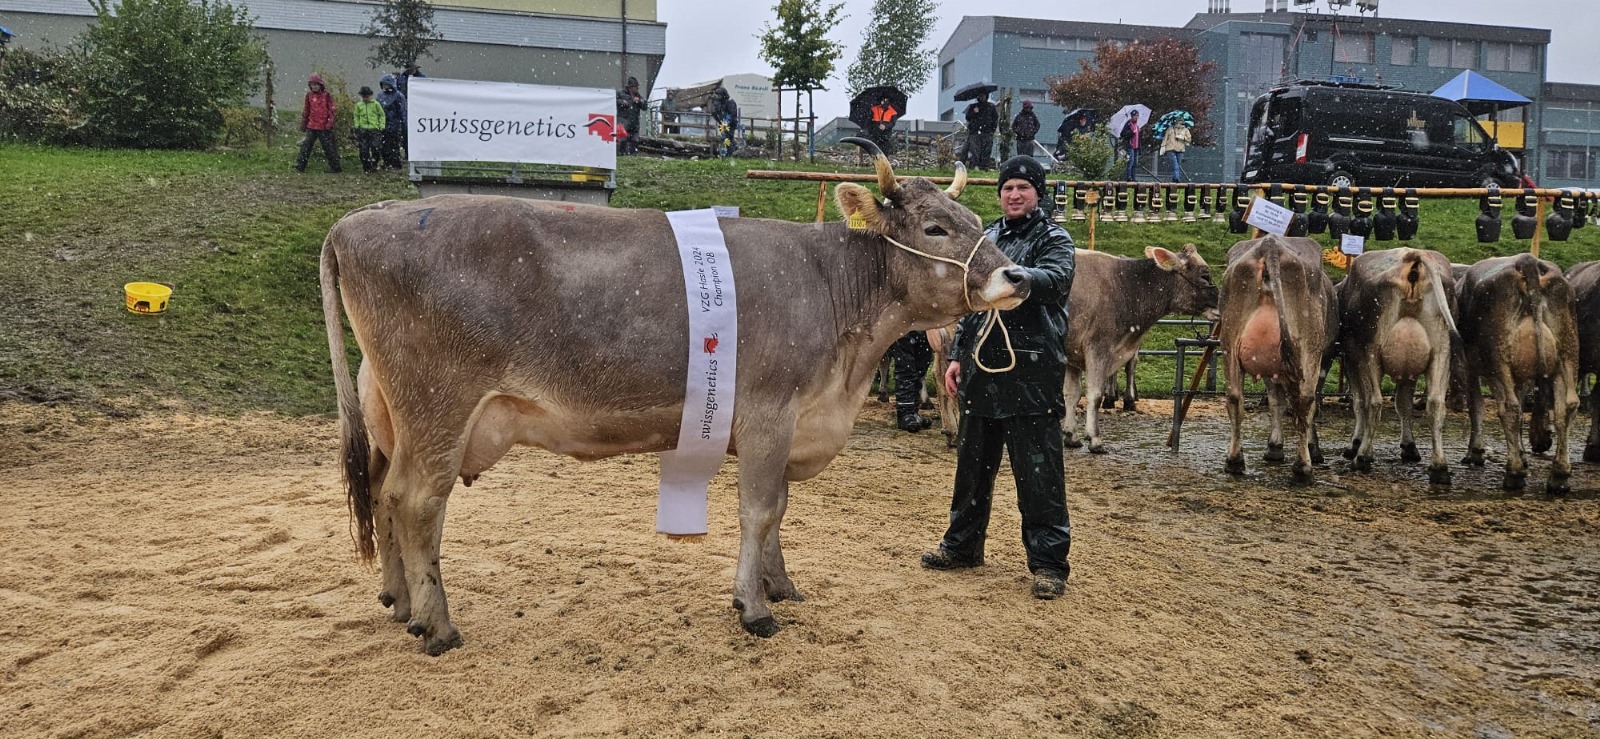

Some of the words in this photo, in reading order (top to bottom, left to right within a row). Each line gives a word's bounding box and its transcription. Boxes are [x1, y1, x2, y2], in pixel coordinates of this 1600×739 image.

[417, 111, 576, 142] swissgenetics
[691, 246, 703, 266] 2024
[696, 268, 707, 290] Hasle
[710, 266, 723, 307] Champion
[701, 292, 711, 313] VZG
[700, 359, 719, 440] swissgenetics
